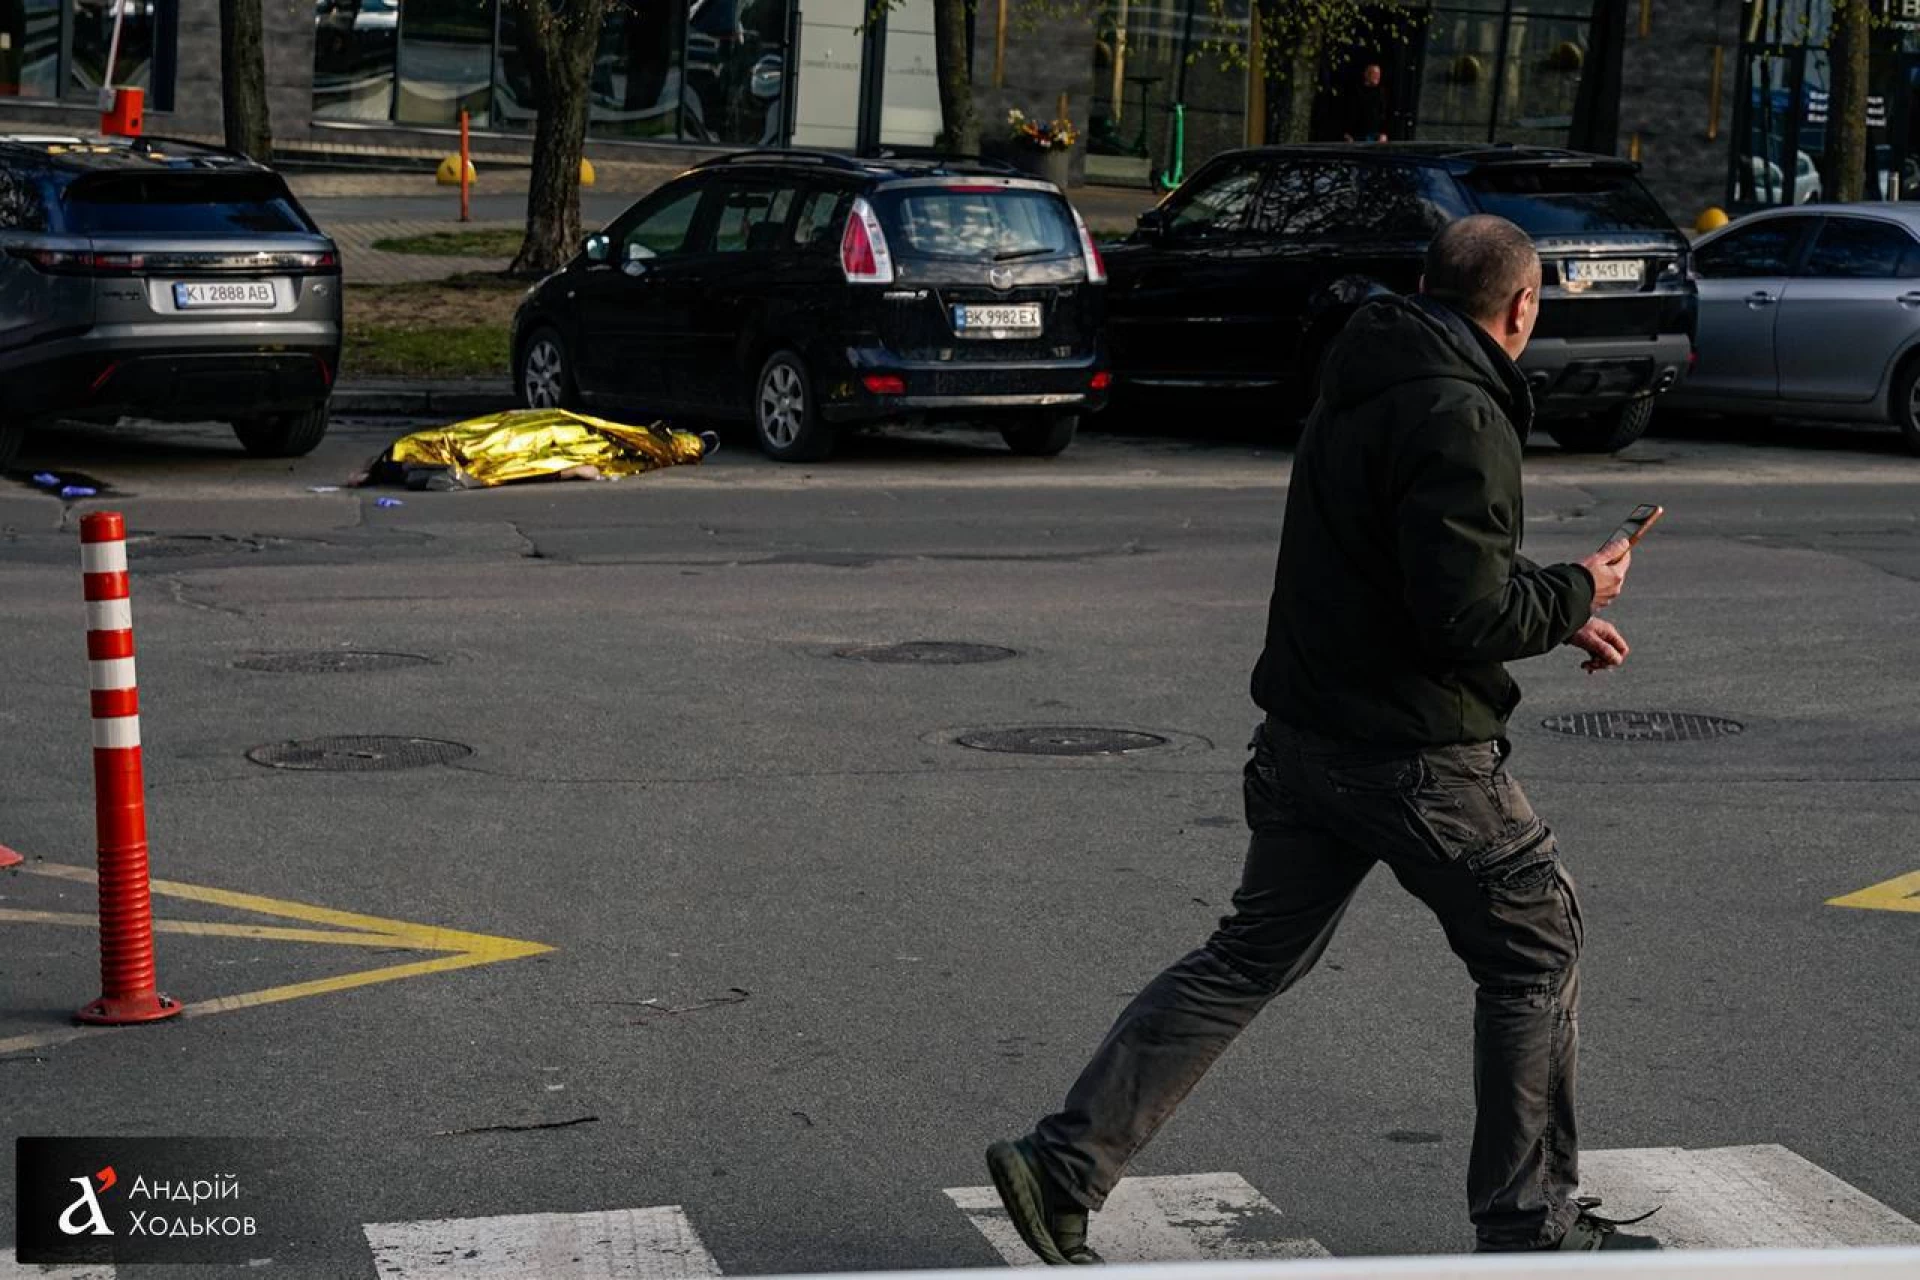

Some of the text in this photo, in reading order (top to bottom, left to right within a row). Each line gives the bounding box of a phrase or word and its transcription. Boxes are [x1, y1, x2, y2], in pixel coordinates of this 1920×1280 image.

[187, 286, 269, 301] KI 2888 AB
[965, 310, 1037, 324] BK 9982 EX
